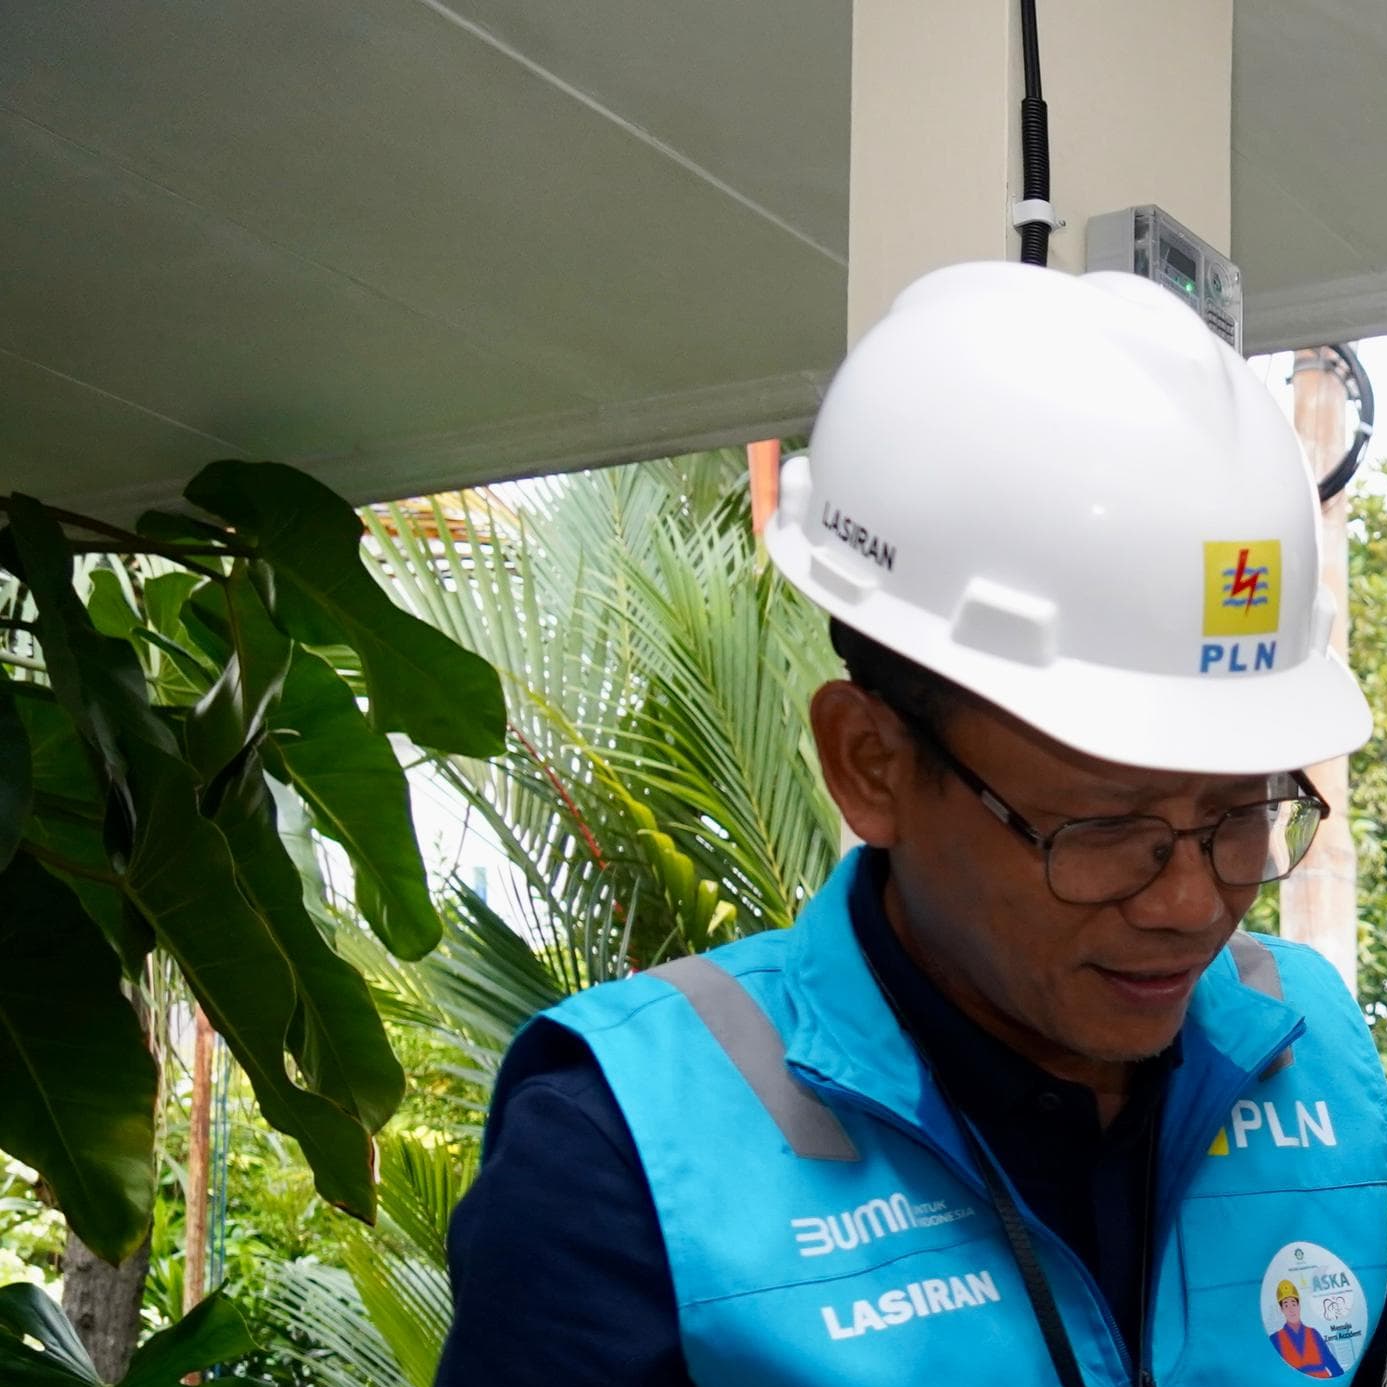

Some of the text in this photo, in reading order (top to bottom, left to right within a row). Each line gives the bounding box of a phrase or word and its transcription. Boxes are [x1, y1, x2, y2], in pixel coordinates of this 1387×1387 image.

[822, 501, 897, 571] LASIRAN
[1200, 640, 1277, 673] PLN
[1231, 1099, 1337, 1148] PLN
[791, 1192, 917, 1257] BUMN
[821, 1270, 1001, 1340] LASIRAN
